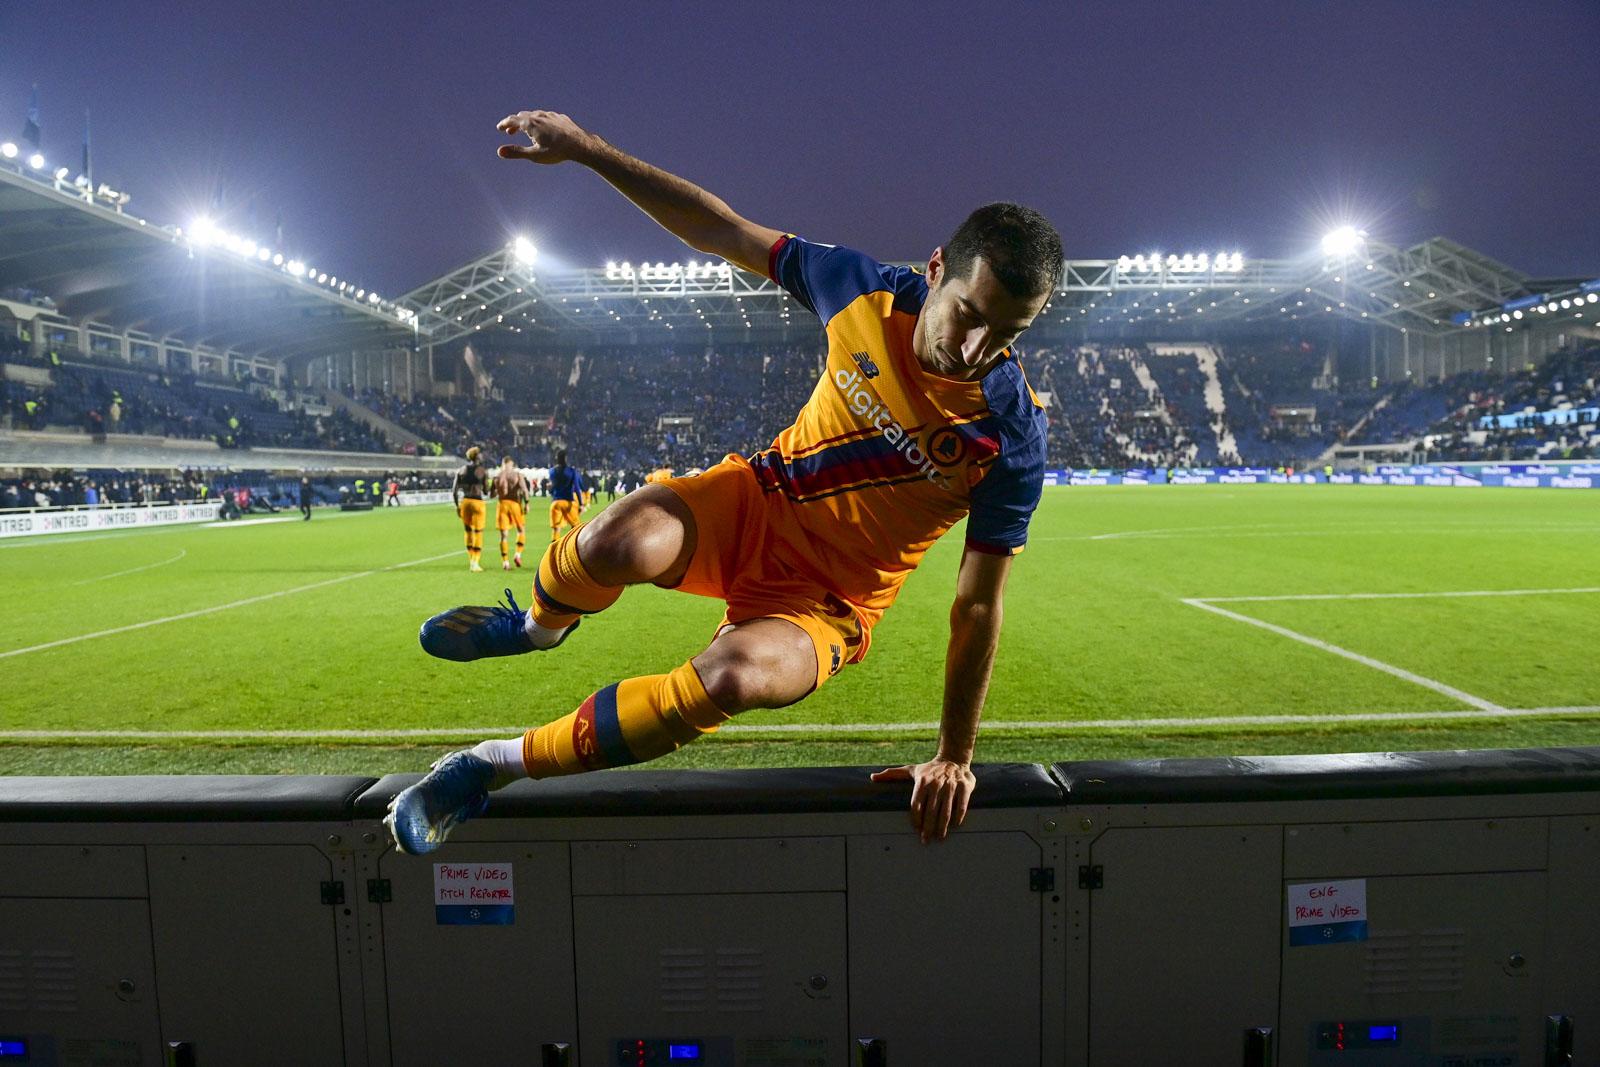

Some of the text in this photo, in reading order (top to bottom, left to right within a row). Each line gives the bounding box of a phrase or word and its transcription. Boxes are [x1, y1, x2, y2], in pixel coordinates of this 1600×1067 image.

[440, 865, 508, 881] PRIME VIDEO
[470, 886, 511, 899] REPORTER
[1309, 886, 1338, 899] ENG
[1295, 904, 1360, 920] PRIME VIDEO
